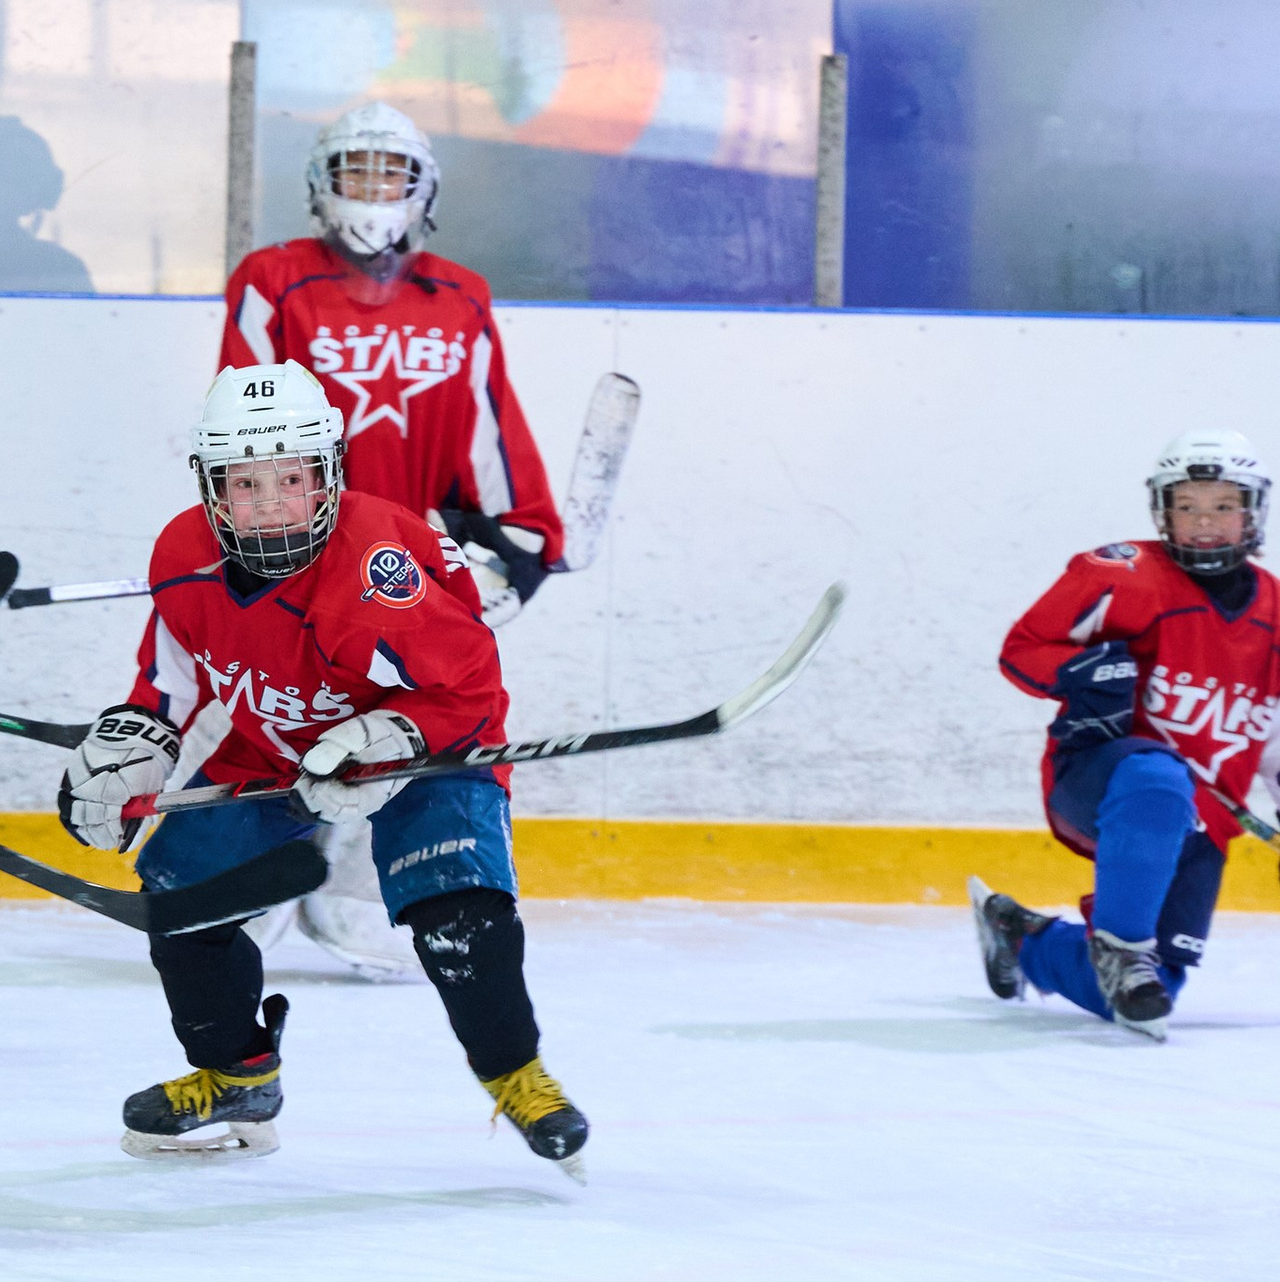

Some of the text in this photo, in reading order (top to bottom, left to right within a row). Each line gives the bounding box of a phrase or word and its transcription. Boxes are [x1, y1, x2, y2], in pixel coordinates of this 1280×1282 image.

[309, 329, 467, 377] STARS
[243, 380, 276, 399] 46
[370, 552, 400, 578] 10
[382, 560, 416, 594] STEPS
[95, 718, 180, 765] BAUE
[463, 731, 594, 765] CCM
